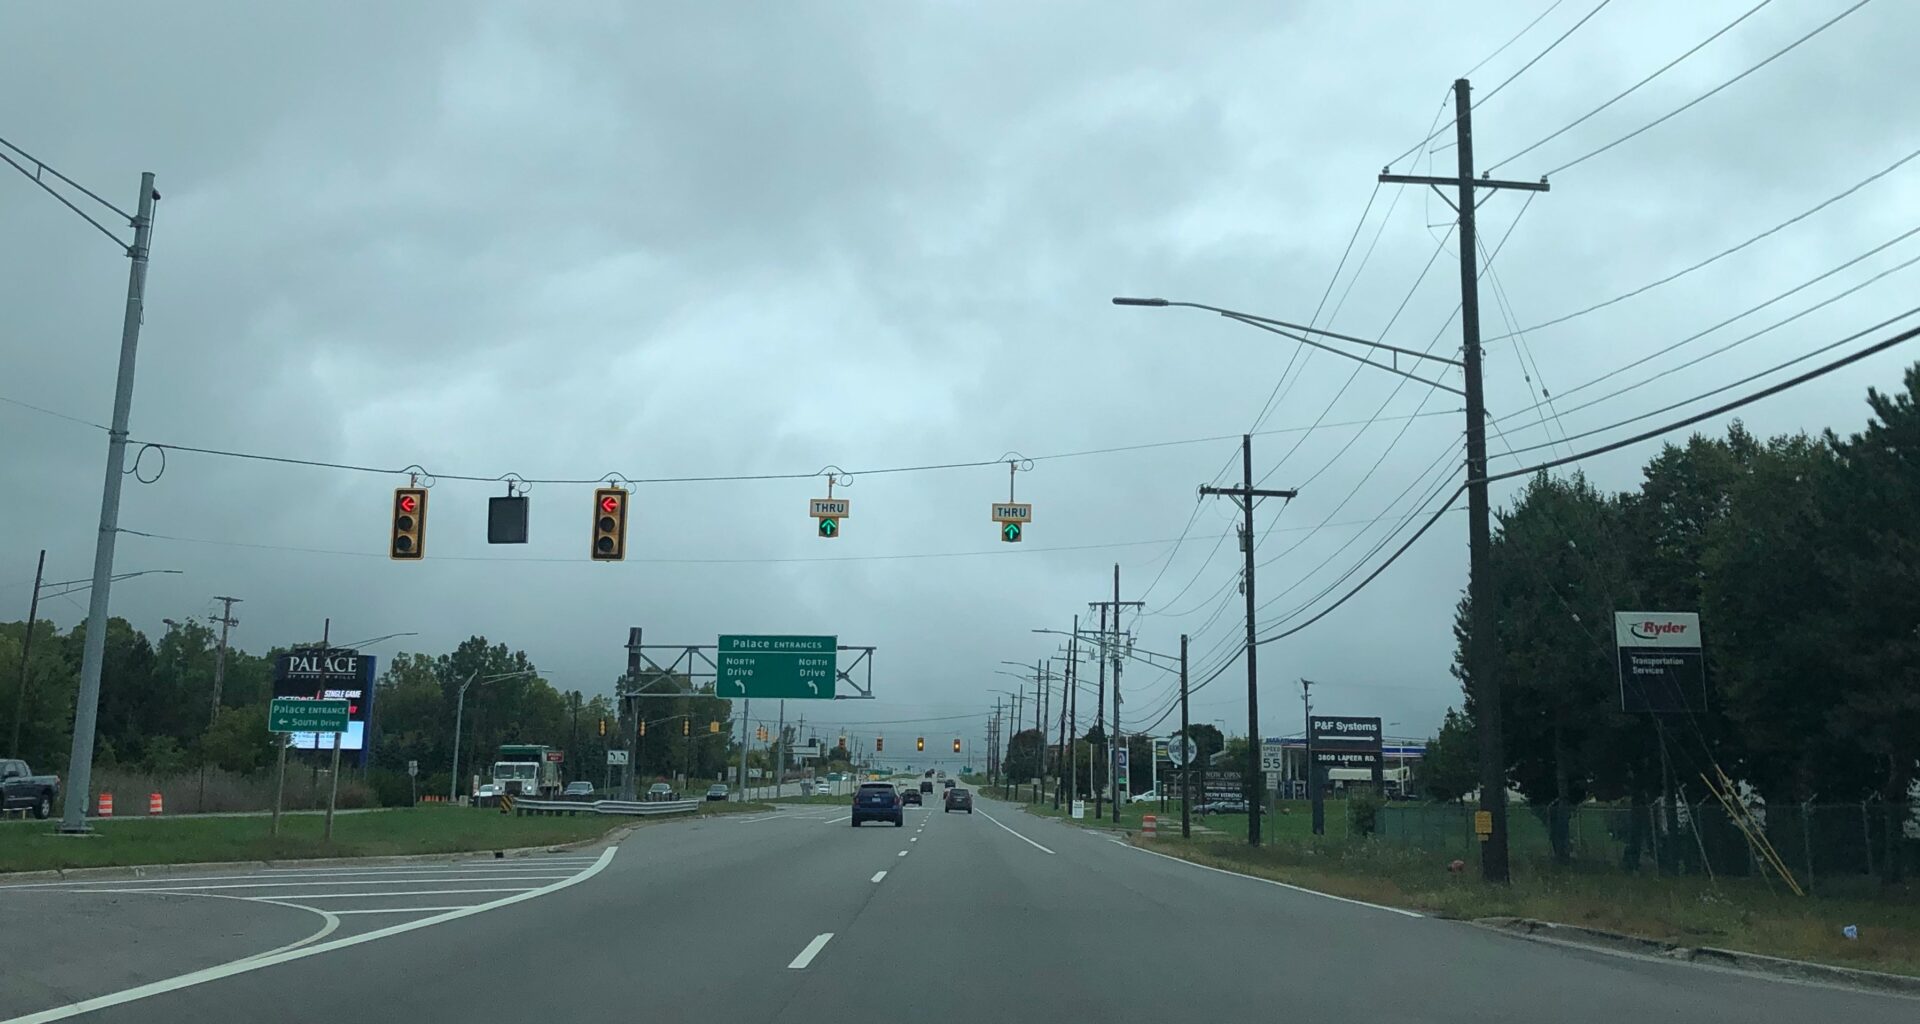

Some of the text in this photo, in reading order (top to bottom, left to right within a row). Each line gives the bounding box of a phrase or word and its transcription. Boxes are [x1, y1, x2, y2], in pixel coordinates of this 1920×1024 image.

[815, 503, 844, 513] THRU
[998, 507, 1027, 518] THRU
[1643, 621, 1687, 635] Ryder
[733, 640, 822, 649] Palace ENTRANCES
[288, 656, 358, 672] PALACE
[726, 657, 755, 665] NORTH
[799, 658, 828, 666] NORTH
[1631, 656, 1684, 667] Transportation
[727, 668, 754, 676] Drive
[799, 669, 826, 677] Drive
[1632, 666, 1664, 675] Services
[273, 705, 306, 715] Palace
[308, 706, 346, 715] ENTRANCE
[292, 719, 341, 727] SOUTH Drive
[1314, 721, 1378, 733] P&F Systems
[1263, 757, 1281, 769] 55
